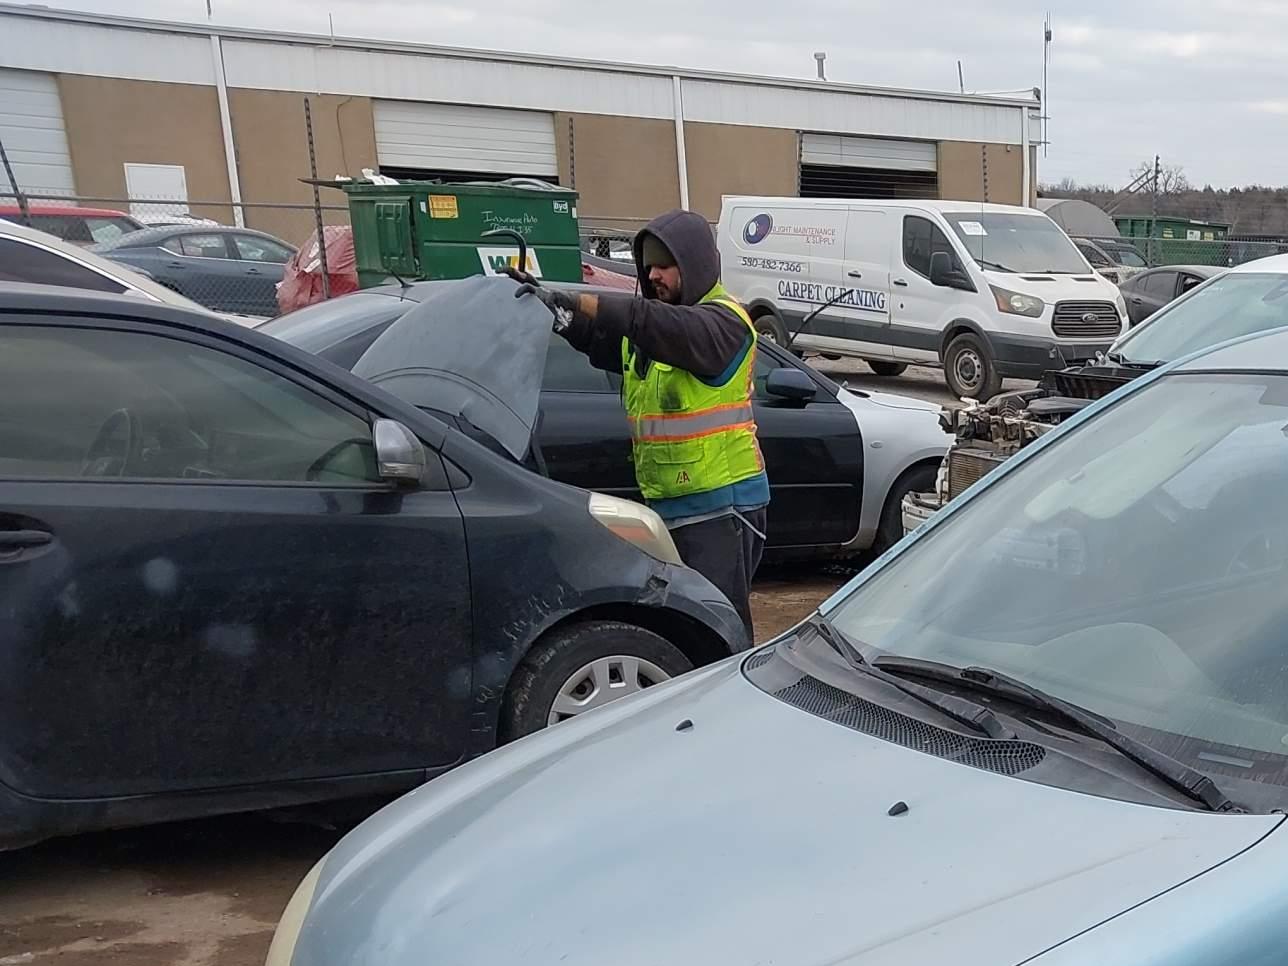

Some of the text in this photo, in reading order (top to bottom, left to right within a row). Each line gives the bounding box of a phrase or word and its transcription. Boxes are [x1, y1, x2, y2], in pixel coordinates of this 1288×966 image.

[812, 236, 836, 245] SUPPLY
[778, 280, 886, 309] CARPET CLEANING
